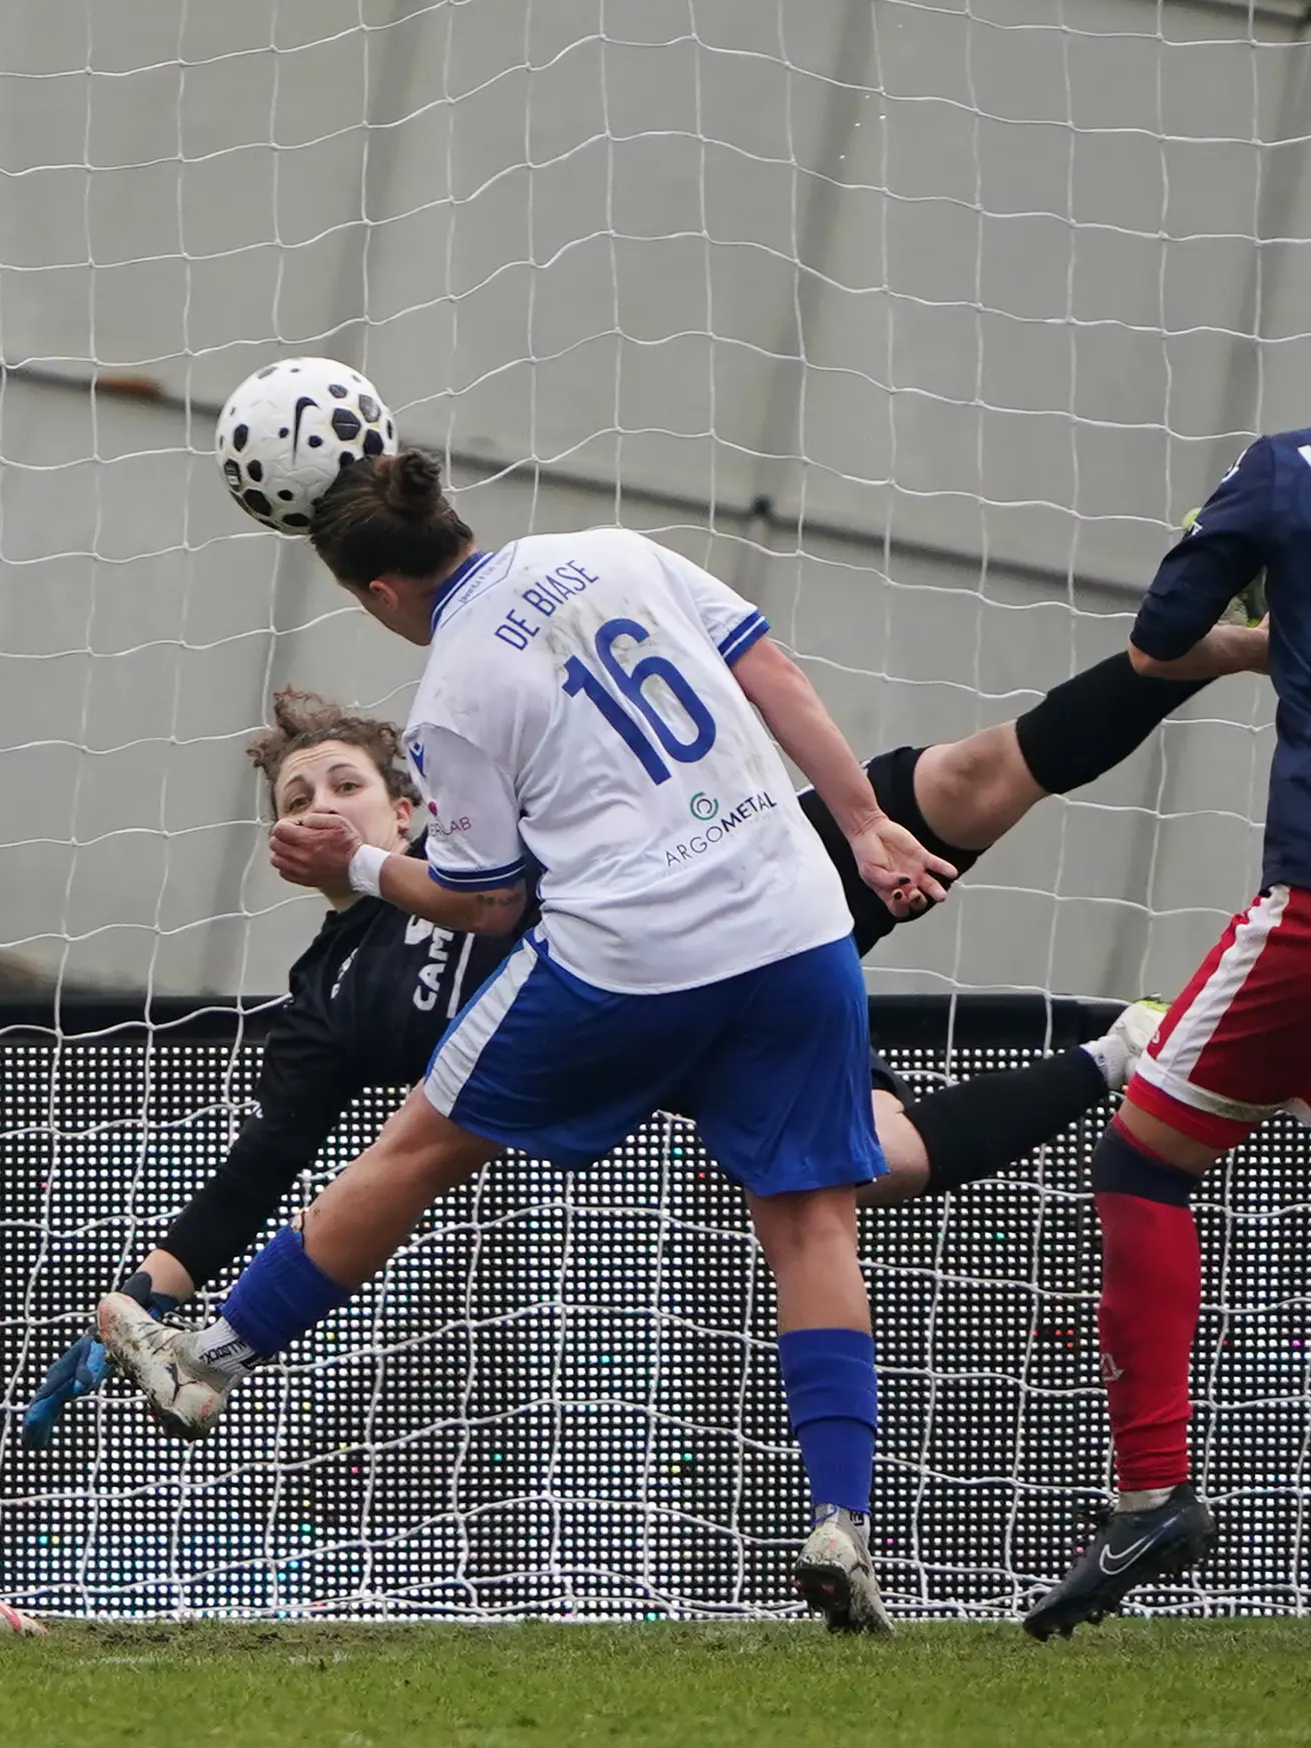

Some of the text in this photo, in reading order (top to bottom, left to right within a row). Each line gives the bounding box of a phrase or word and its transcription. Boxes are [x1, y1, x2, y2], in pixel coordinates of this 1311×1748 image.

[494, 608, 540, 651] DE
[523, 559, 600, 617] BIASE
[561, 617, 717, 786] 16
[665, 791, 777, 866] ARGOMETAL
